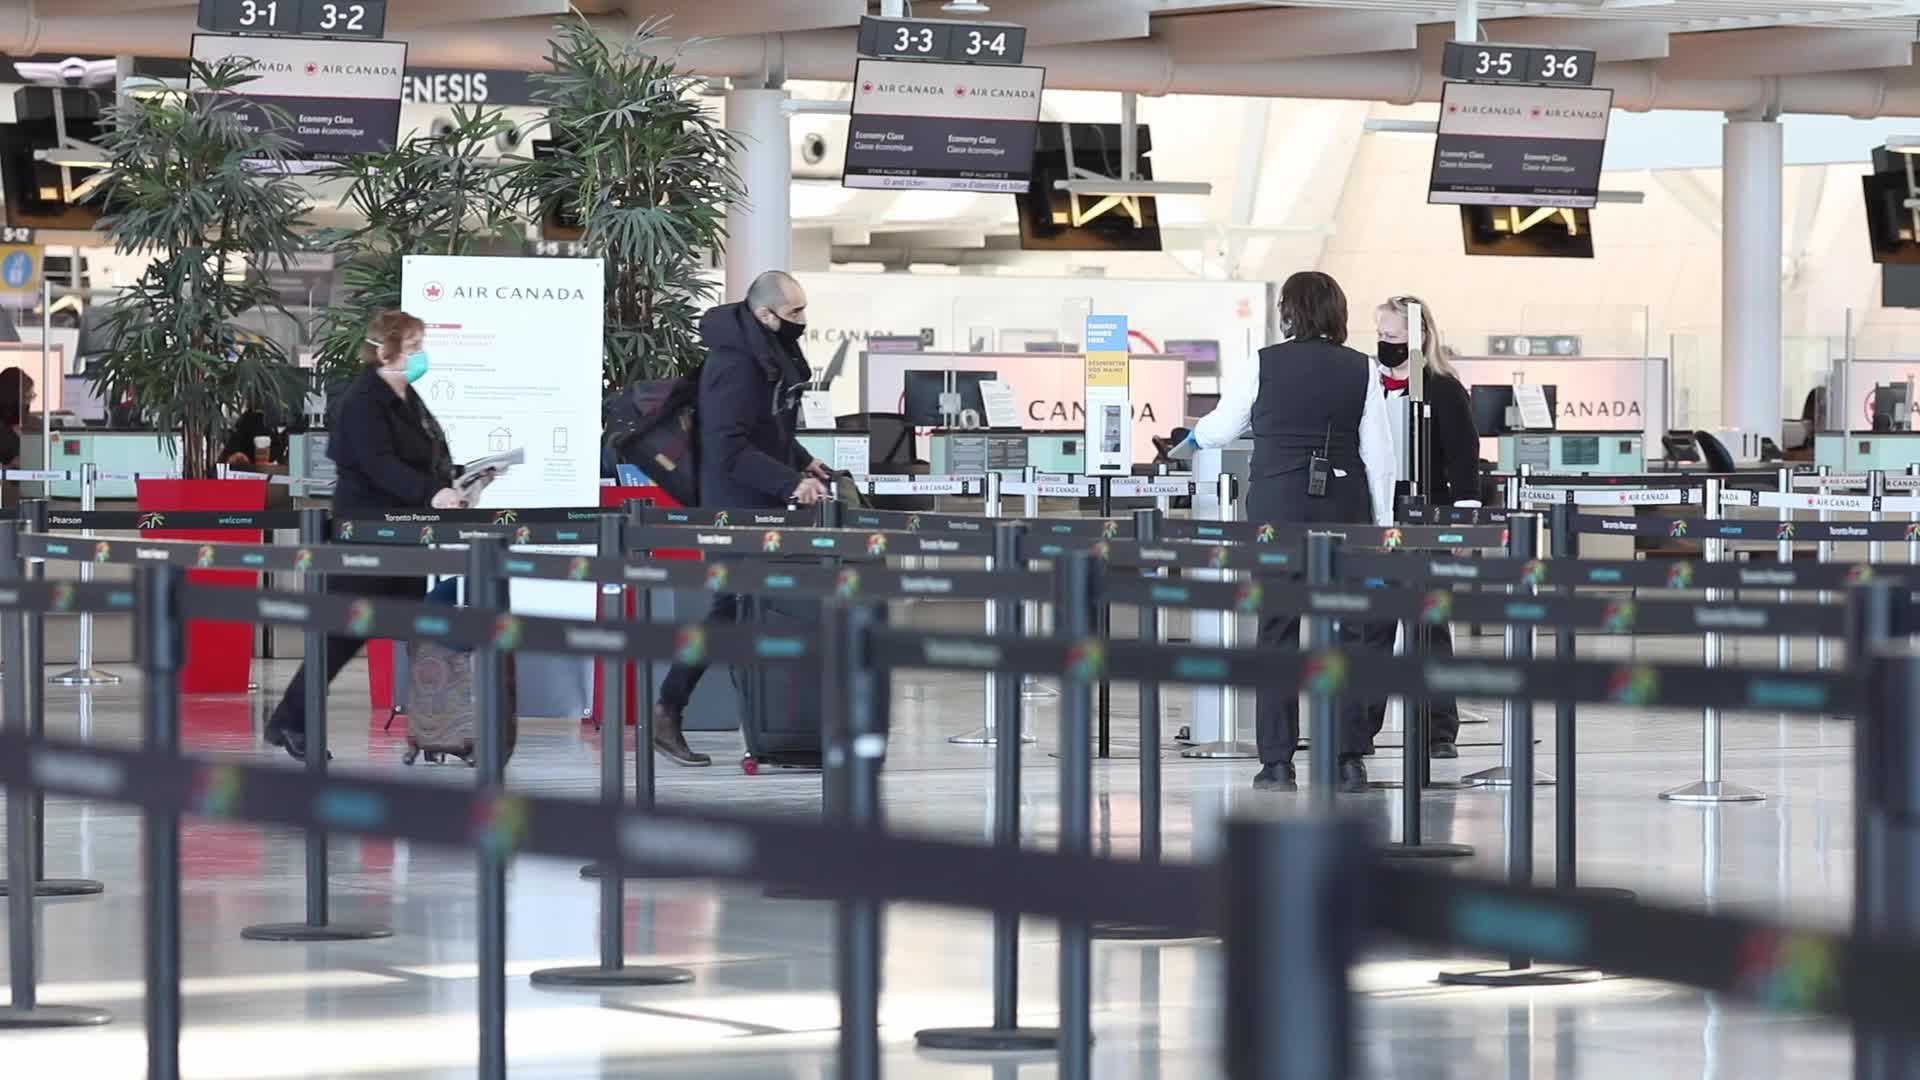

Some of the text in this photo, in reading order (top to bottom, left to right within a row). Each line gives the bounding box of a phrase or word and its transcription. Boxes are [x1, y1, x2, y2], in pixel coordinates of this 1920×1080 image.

[239, 1, 277, 27] 3-1
[319, 4, 366, 31] 3-2
[893, 27, 934, 53] 3-3
[966, 31, 1007, 56] 3-4
[247, 63, 293, 73] ANADA
[1475, 51, 1513, 76] 3-5
[1541, 54, 1578, 79] 3-6
[322, 64, 398, 76] AIR CANADA
[402, 72, 489, 104] ENESIS
[877, 84, 945, 96] AIR CANADA
[969, 88, 1036, 99] AIR CANADA
[1461, 106, 1522, 116] AIR CANADA
[1545, 110, 1604, 120] AIR CANADA
[298, 114, 354, 126] Economy Class
[454, 285, 585, 301] AIR CANADA
[1558, 400, 1642, 417] ANADA
[1528, 491, 1556, 500] CANADA
[1628, 493, 1669, 501] AIR CANADA
[1816, 499, 1860, 508] AIR CANADA
[52, 516, 82, 525] Pearson
[218, 516, 253, 525] welcome
[385, 513, 440, 523] Toronto Pearson
